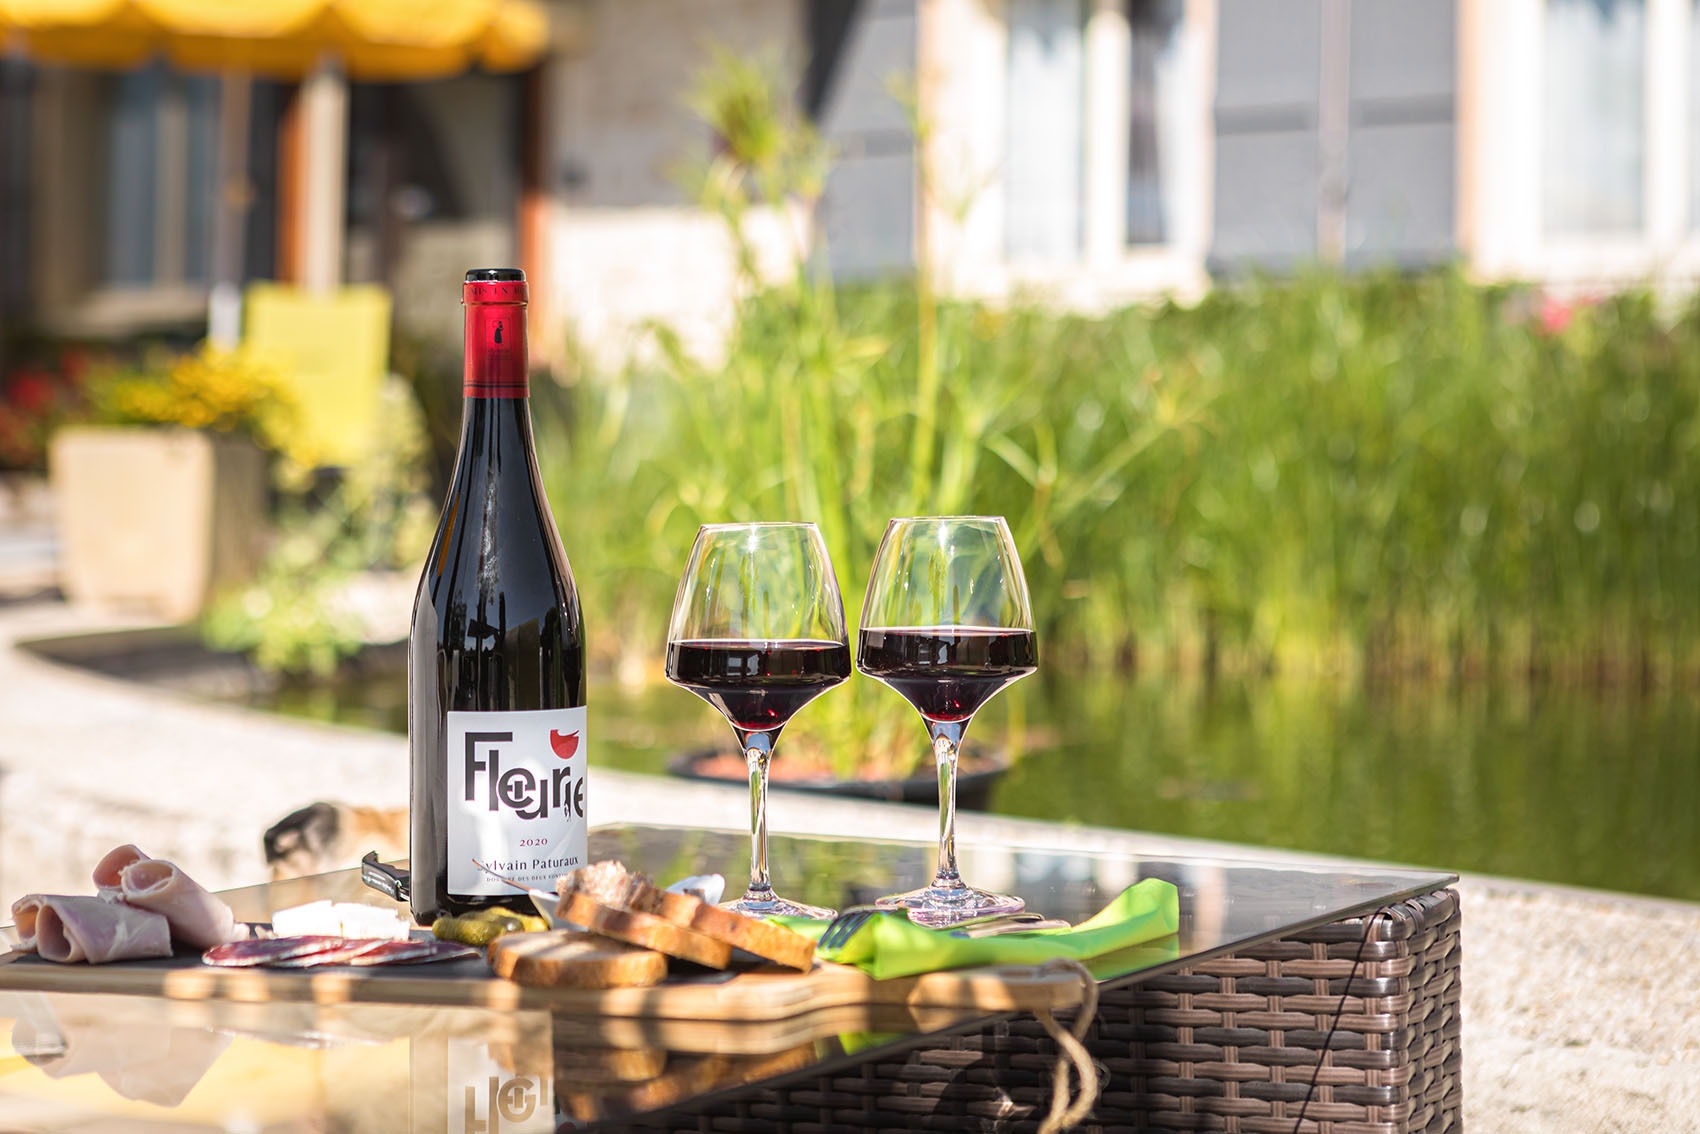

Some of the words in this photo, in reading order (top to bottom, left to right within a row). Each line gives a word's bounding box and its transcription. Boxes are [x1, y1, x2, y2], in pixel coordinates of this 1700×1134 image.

[465, 732, 584, 821] Fleurie
[519, 838, 548, 847] 2020
[532, 856, 579, 869] Paturaux
